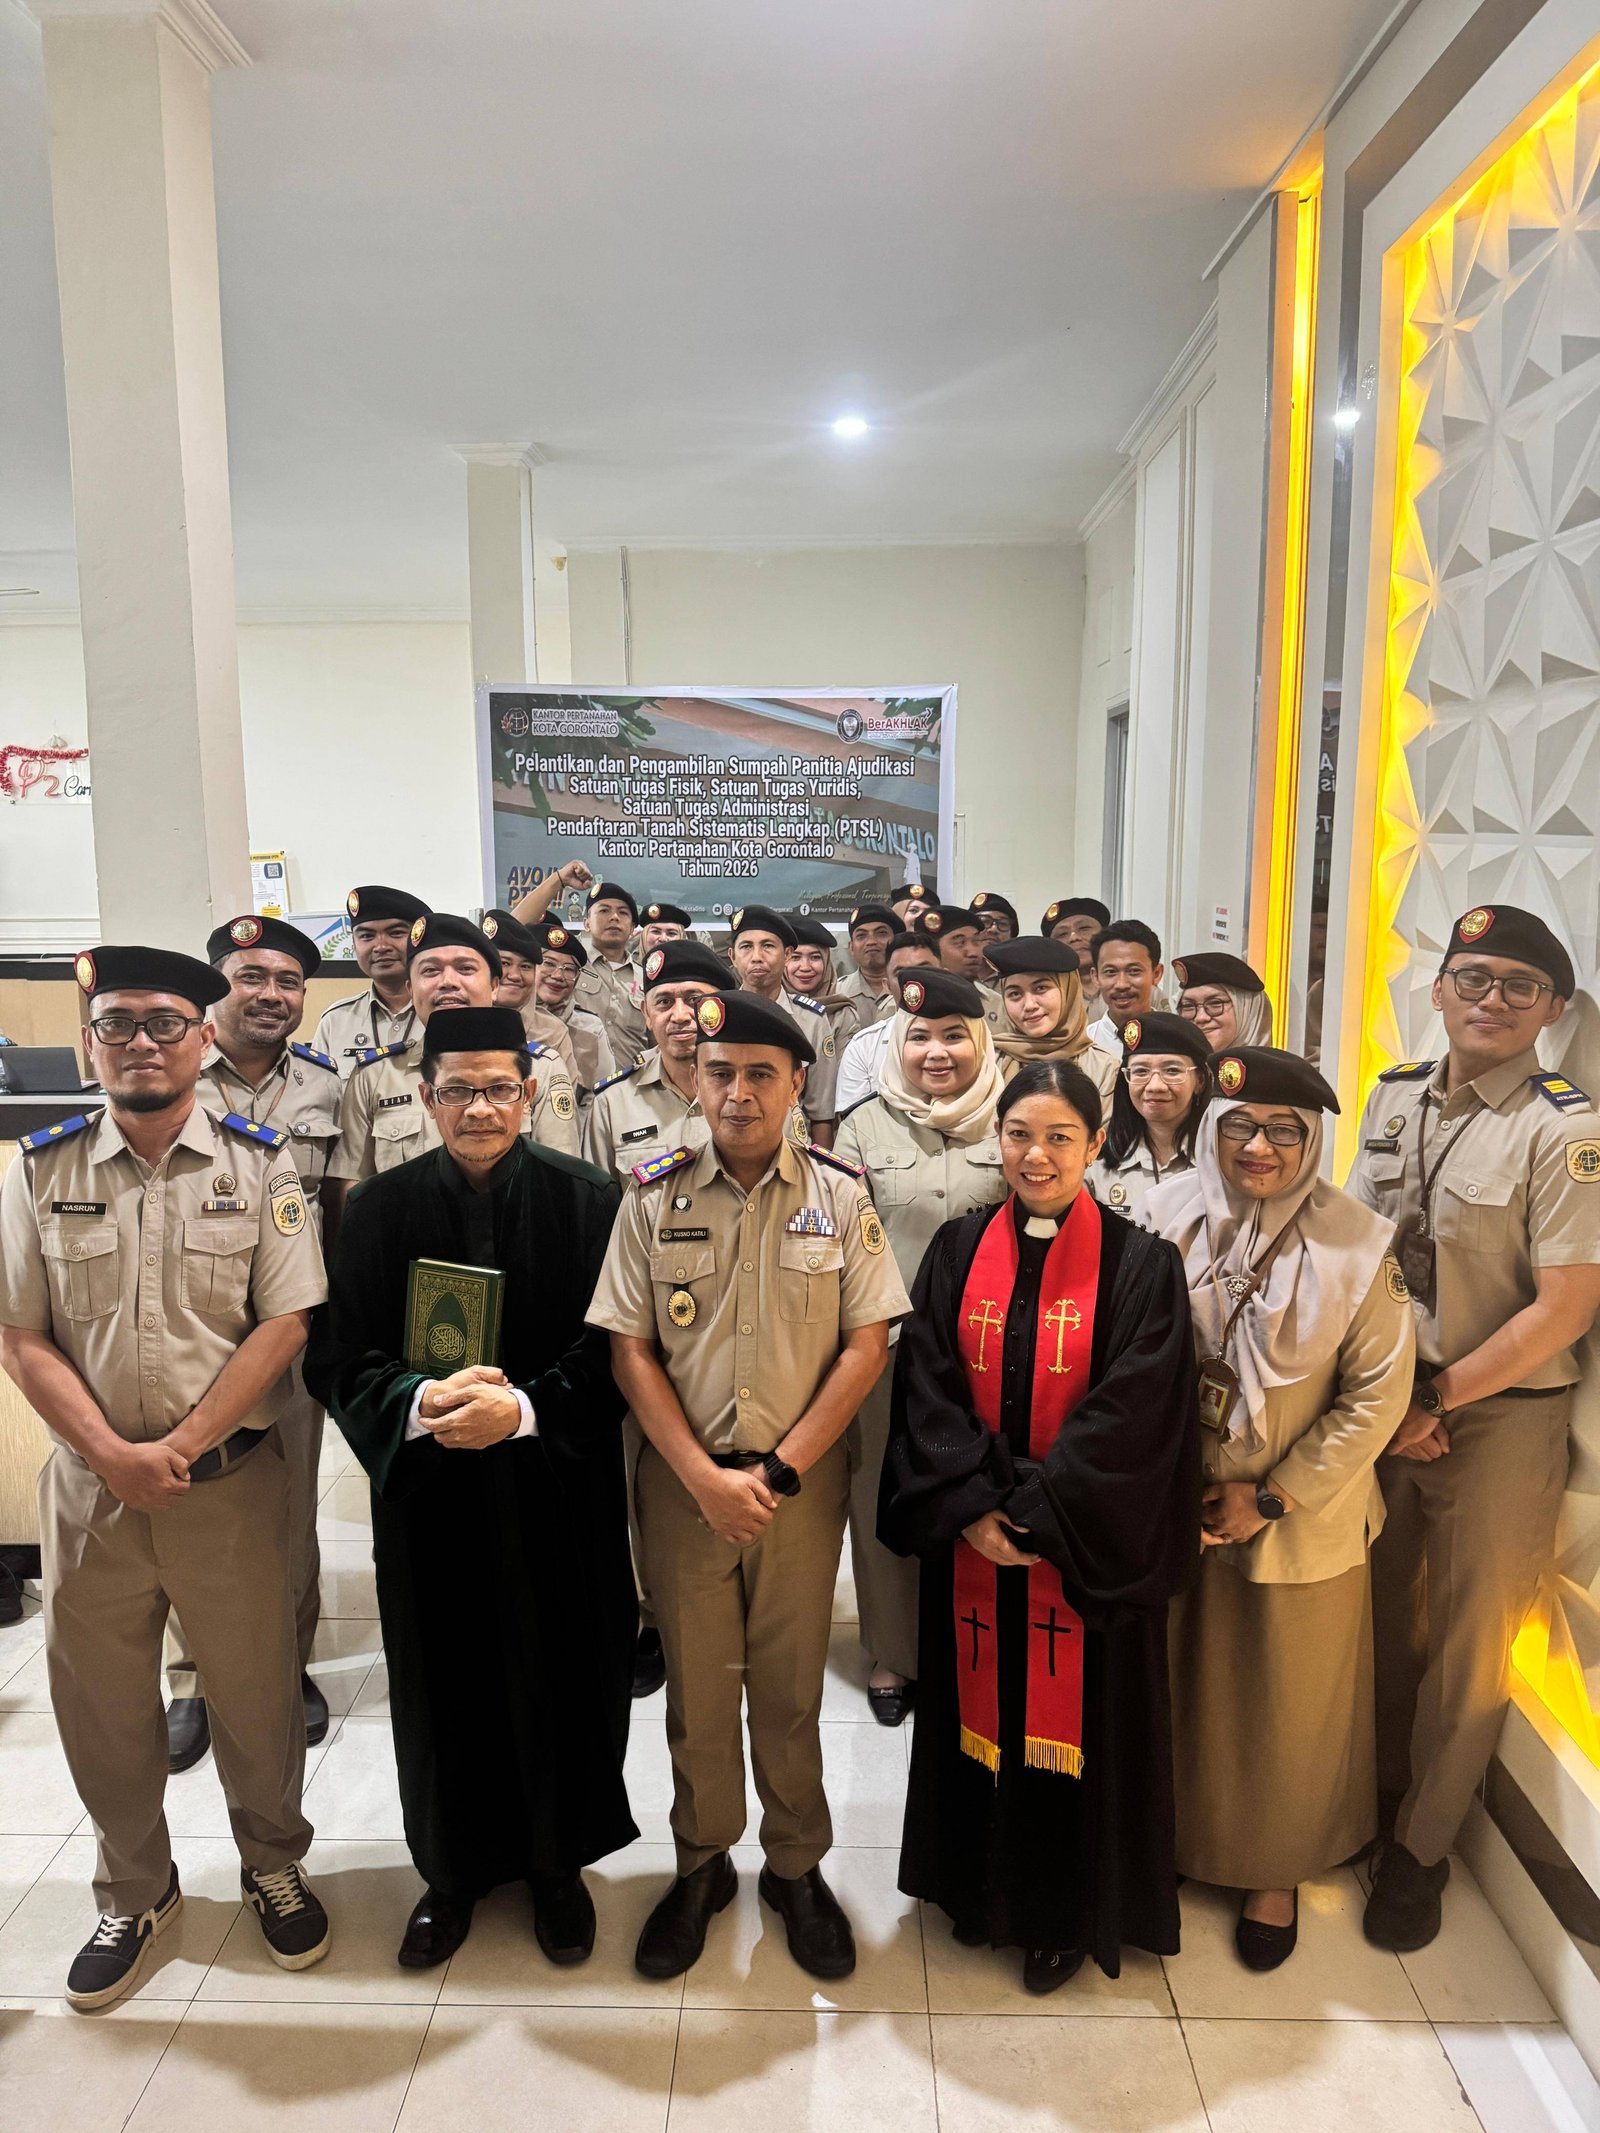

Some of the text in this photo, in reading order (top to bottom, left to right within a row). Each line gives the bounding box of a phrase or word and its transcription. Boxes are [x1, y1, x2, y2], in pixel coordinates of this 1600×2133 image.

[533, 710, 617, 721] KANTOR PERTANAHAN
[868, 718, 928, 729] BerAKHLAK
[533, 723, 618, 736] KOTA GORONTALO
[515, 753, 914, 779] Pelantikan dan Pengambilan Sumpah Panitia Ajudikasi
[570, 777, 618, 794] Satuan
[623, 778, 665, 797] Tugas
[670, 778, 706, 798] Fisik,
[711, 778, 758, 797] Satuan
[763, 779, 805, 799] Tugas
[809, 778, 861, 799] Yuridis,
[623, 799, 809, 818] Satuan Tugas Administrasi
[548, 817, 637, 836] Pendaftaran
[641, 818, 685, 836] Tanah
[690, 818, 765, 838] Sistematis
[770, 820, 830, 841] Lengkap
[835, 818, 884, 842] (PTSL)
[599, 839, 834, 858] Kantor Pertanahan Kota Gorontalo
[679, 860, 758, 877] Tahun 2026
[61, 1204, 96, 1212] NASRUN
